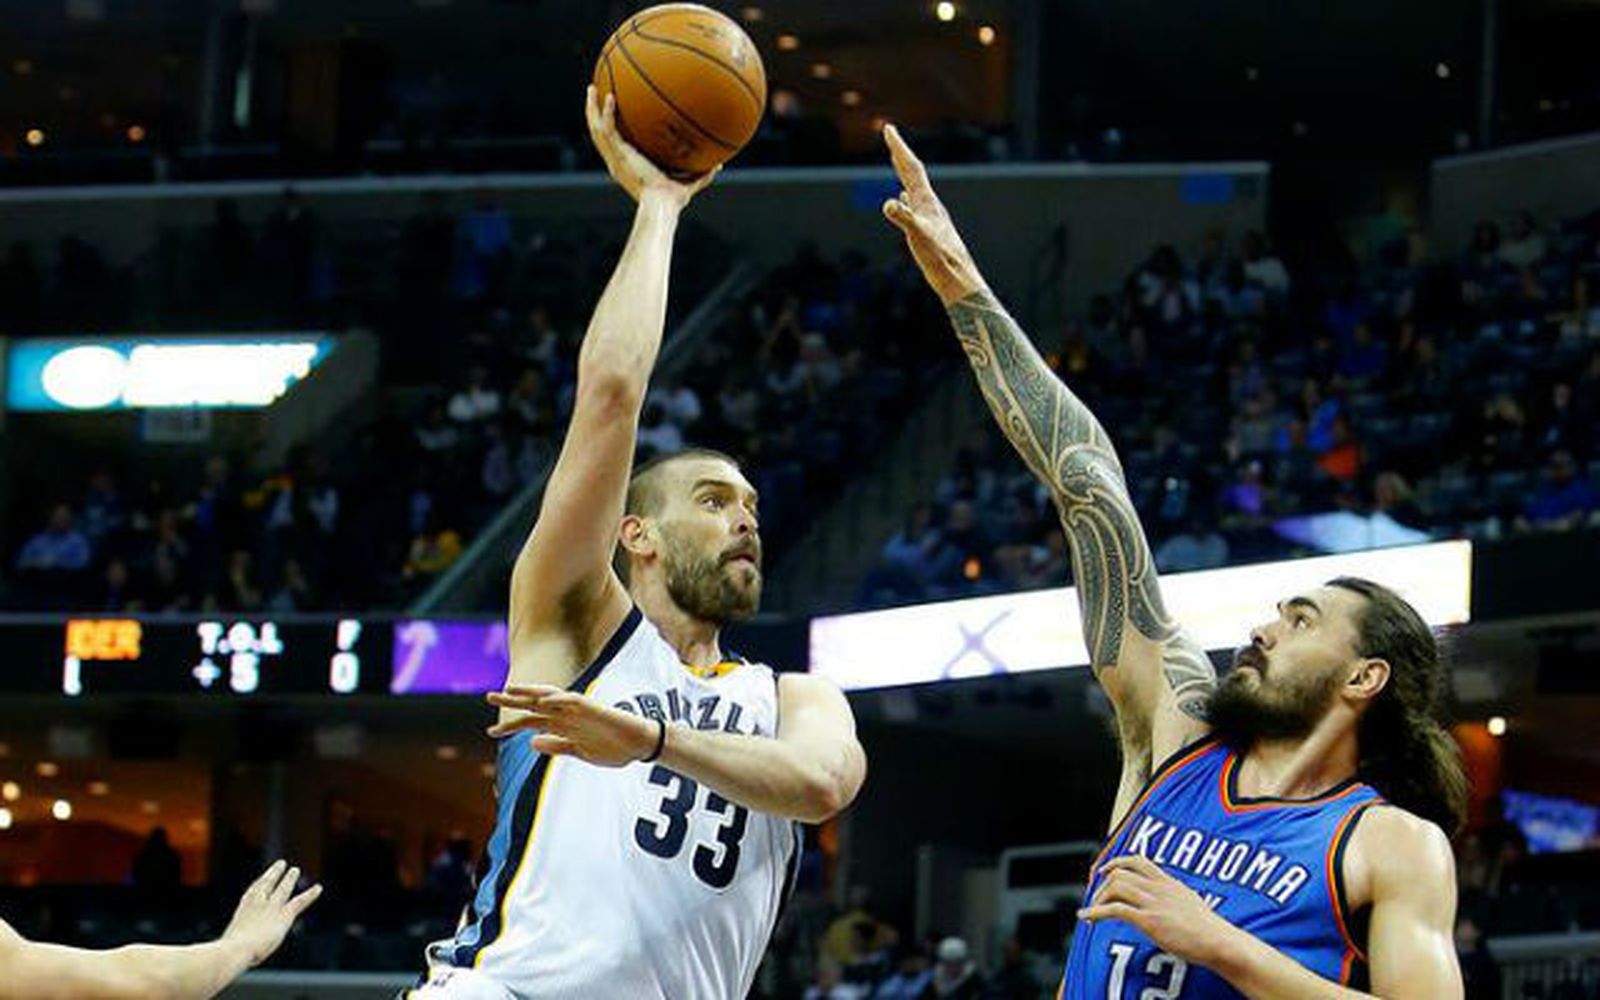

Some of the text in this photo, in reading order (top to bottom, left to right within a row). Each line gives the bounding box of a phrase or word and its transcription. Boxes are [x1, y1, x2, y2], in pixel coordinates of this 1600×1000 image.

[330, 653, 359, 692] 0
[634, 764, 748, 889] 33
[1125, 814, 1309, 905] KLAHOMA
[1107, 943, 1188, 1000] 12
